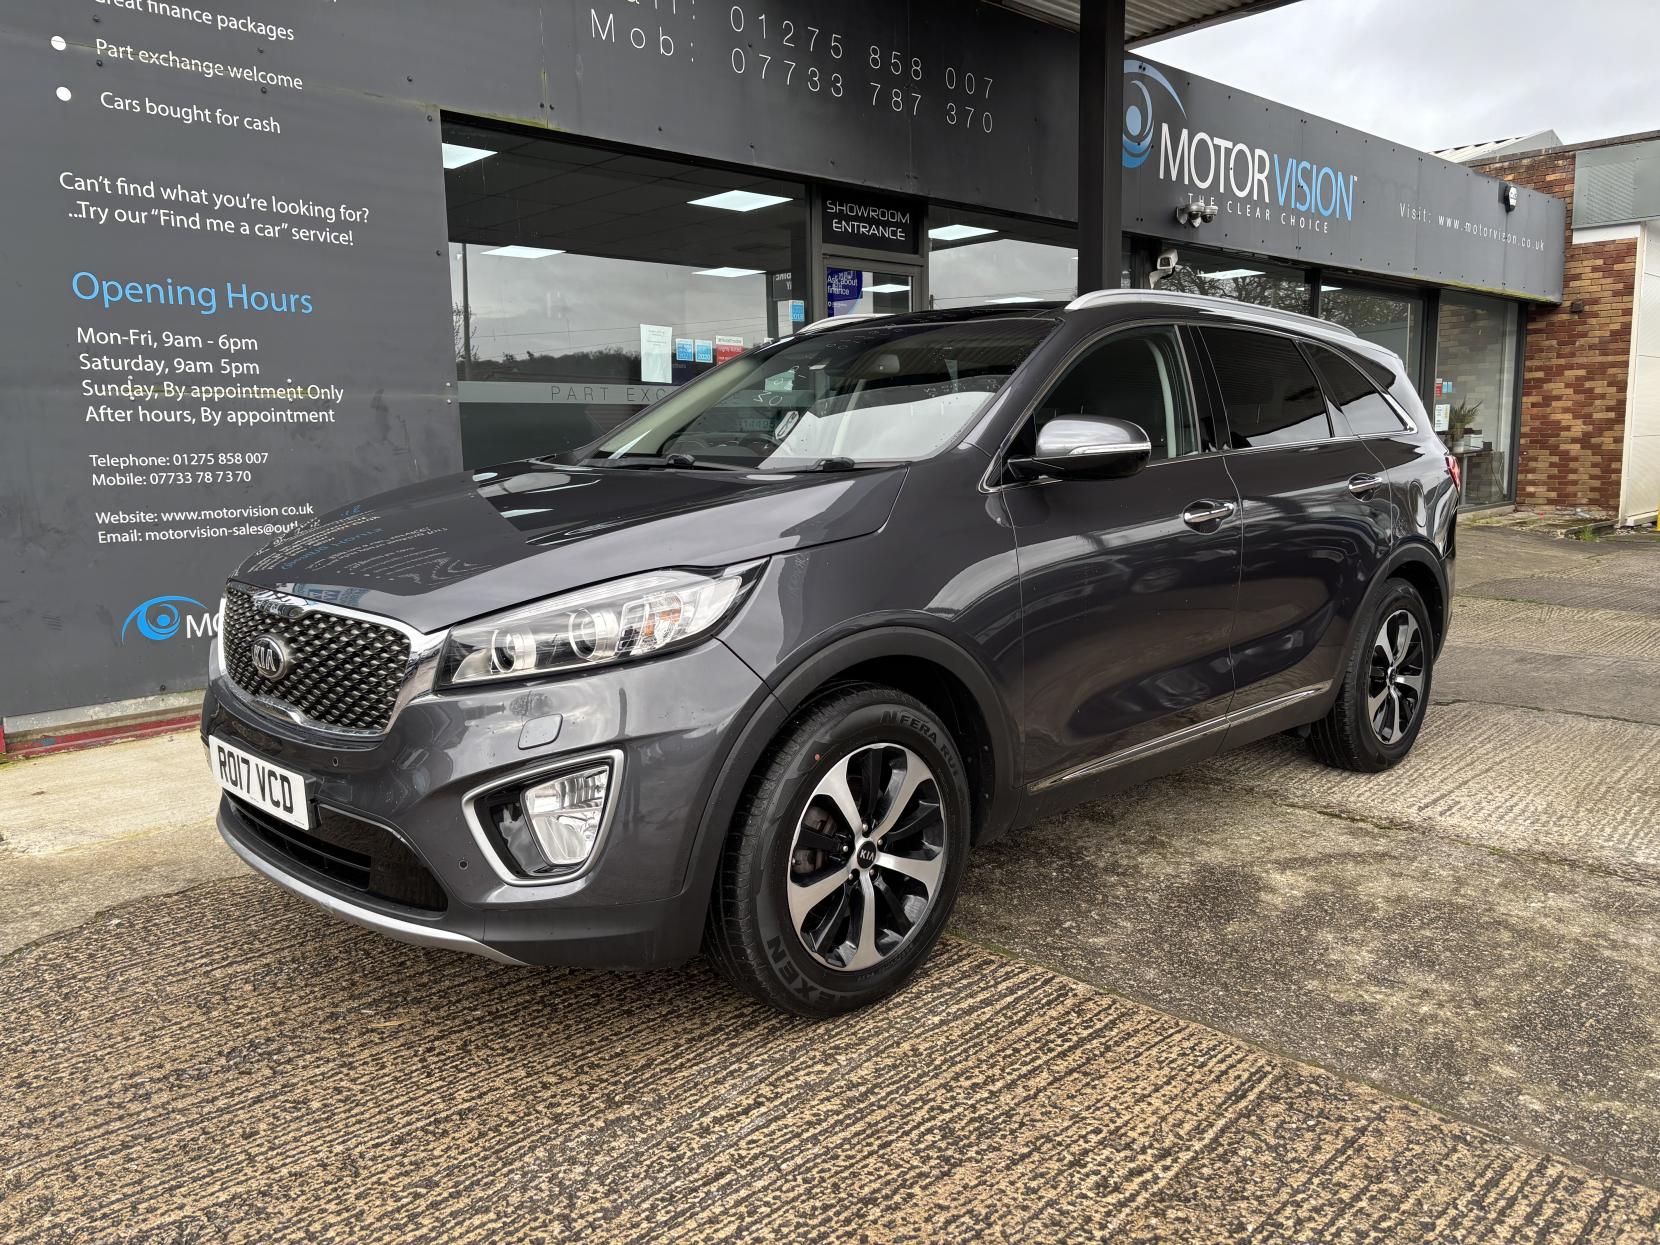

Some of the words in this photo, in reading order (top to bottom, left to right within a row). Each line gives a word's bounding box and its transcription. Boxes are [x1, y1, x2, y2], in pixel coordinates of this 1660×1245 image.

[95, 0, 143, 11] eat
[147, 0, 212, 24] finance
[217, 14, 295, 41] packages
[591, 8, 694, 63] Mob:
[96, 38, 134, 61] Part
[138, 49, 224, 78] exchange
[227, 64, 303, 90] welcome
[730, 6, 843, 59] 01275
[869, 45, 922, 80] 858
[945, 67, 993, 99] 007
[731, 48, 844, 98] 07733
[870, 82, 921, 115] 787
[946, 102, 993, 133] 370
[100, 92, 141, 113] Cars
[145, 98, 212, 125] bought
[214, 107, 240, 129] for
[243, 115, 281, 134] cash
[59, 172, 112, 195] Can't
[115, 178, 155, 199] find
[160, 184, 208, 206] what
[213, 192, 267, 212] you're
[272, 198, 335, 223] looking
[339, 205, 370, 224] for?
[826, 200, 910, 224] SHOWROOM
[1188, 193, 1215, 207] THE
[1226, 201, 1270, 221] CLEAR
[1281, 213, 1328, 233] CHOICE
[1400, 202, 1432, 224] Visit:
[114, 208, 148, 225] our
[151, 208, 201, 230] "Find
[206, 216, 235, 234] me
[239, 221, 250, 236] a
[254, 222, 288, 239] car"
[291, 227, 354, 246] service!
[832, 219, 906, 240] ENTRANCE
[72, 271, 217, 315] Opening
[226, 282, 313, 314] Hours
[77, 327, 158, 349] Mon-Fri,
[162, 331, 203, 348] 9am
[218, 335, 258, 353] 6pm
[79, 354, 169, 375] Saturday,
[173, 358, 213, 373] 9am
[220, 359, 260, 377] 5pm
[82, 379, 158, 400] Sunday,
[164, 381, 185, 401] By
[190, 384, 304, 402] appointment
[307, 384, 344, 403] Only
[551, 385, 609, 401] PART
[85, 406, 134, 422] After
[138, 406, 196, 424] hours,
[200, 407, 222, 426] By
[227, 408, 335, 426] appointment
[89, 454, 170, 469] Telephone:
[172, 453, 215, 466] 01275
[218, 453, 243, 465] 858
[245, 452, 269, 464] 007
[92, 472, 147, 486] Mobile:
[150, 472, 192, 485] 07733
[96, 511, 158, 524] Website:
[97, 529, 143, 544] Email:
[253, 644, 276, 671] KIA
[218, 745, 251, 795] RO17
[254, 763, 294, 814] VCD
[859, 849, 876, 862] KIA
